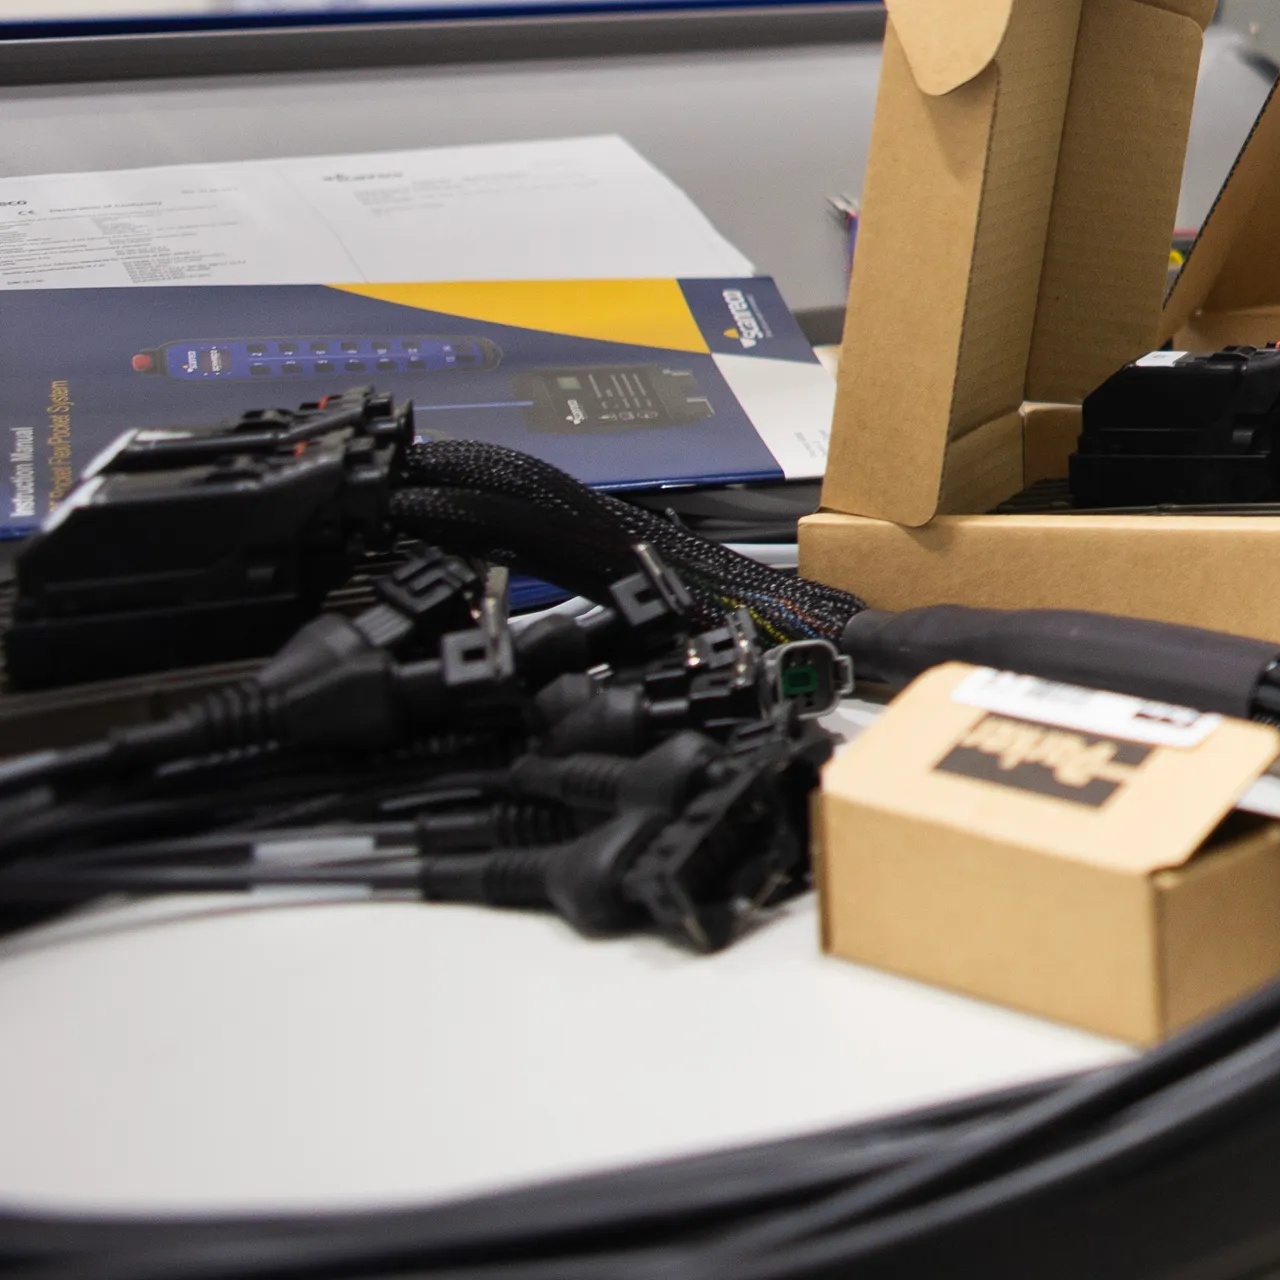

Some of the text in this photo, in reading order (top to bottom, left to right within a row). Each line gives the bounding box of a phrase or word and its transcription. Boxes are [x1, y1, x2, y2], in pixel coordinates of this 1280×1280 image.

[47, 380, 75, 413] System
[9, 426, 36, 518] Instruction Manual
